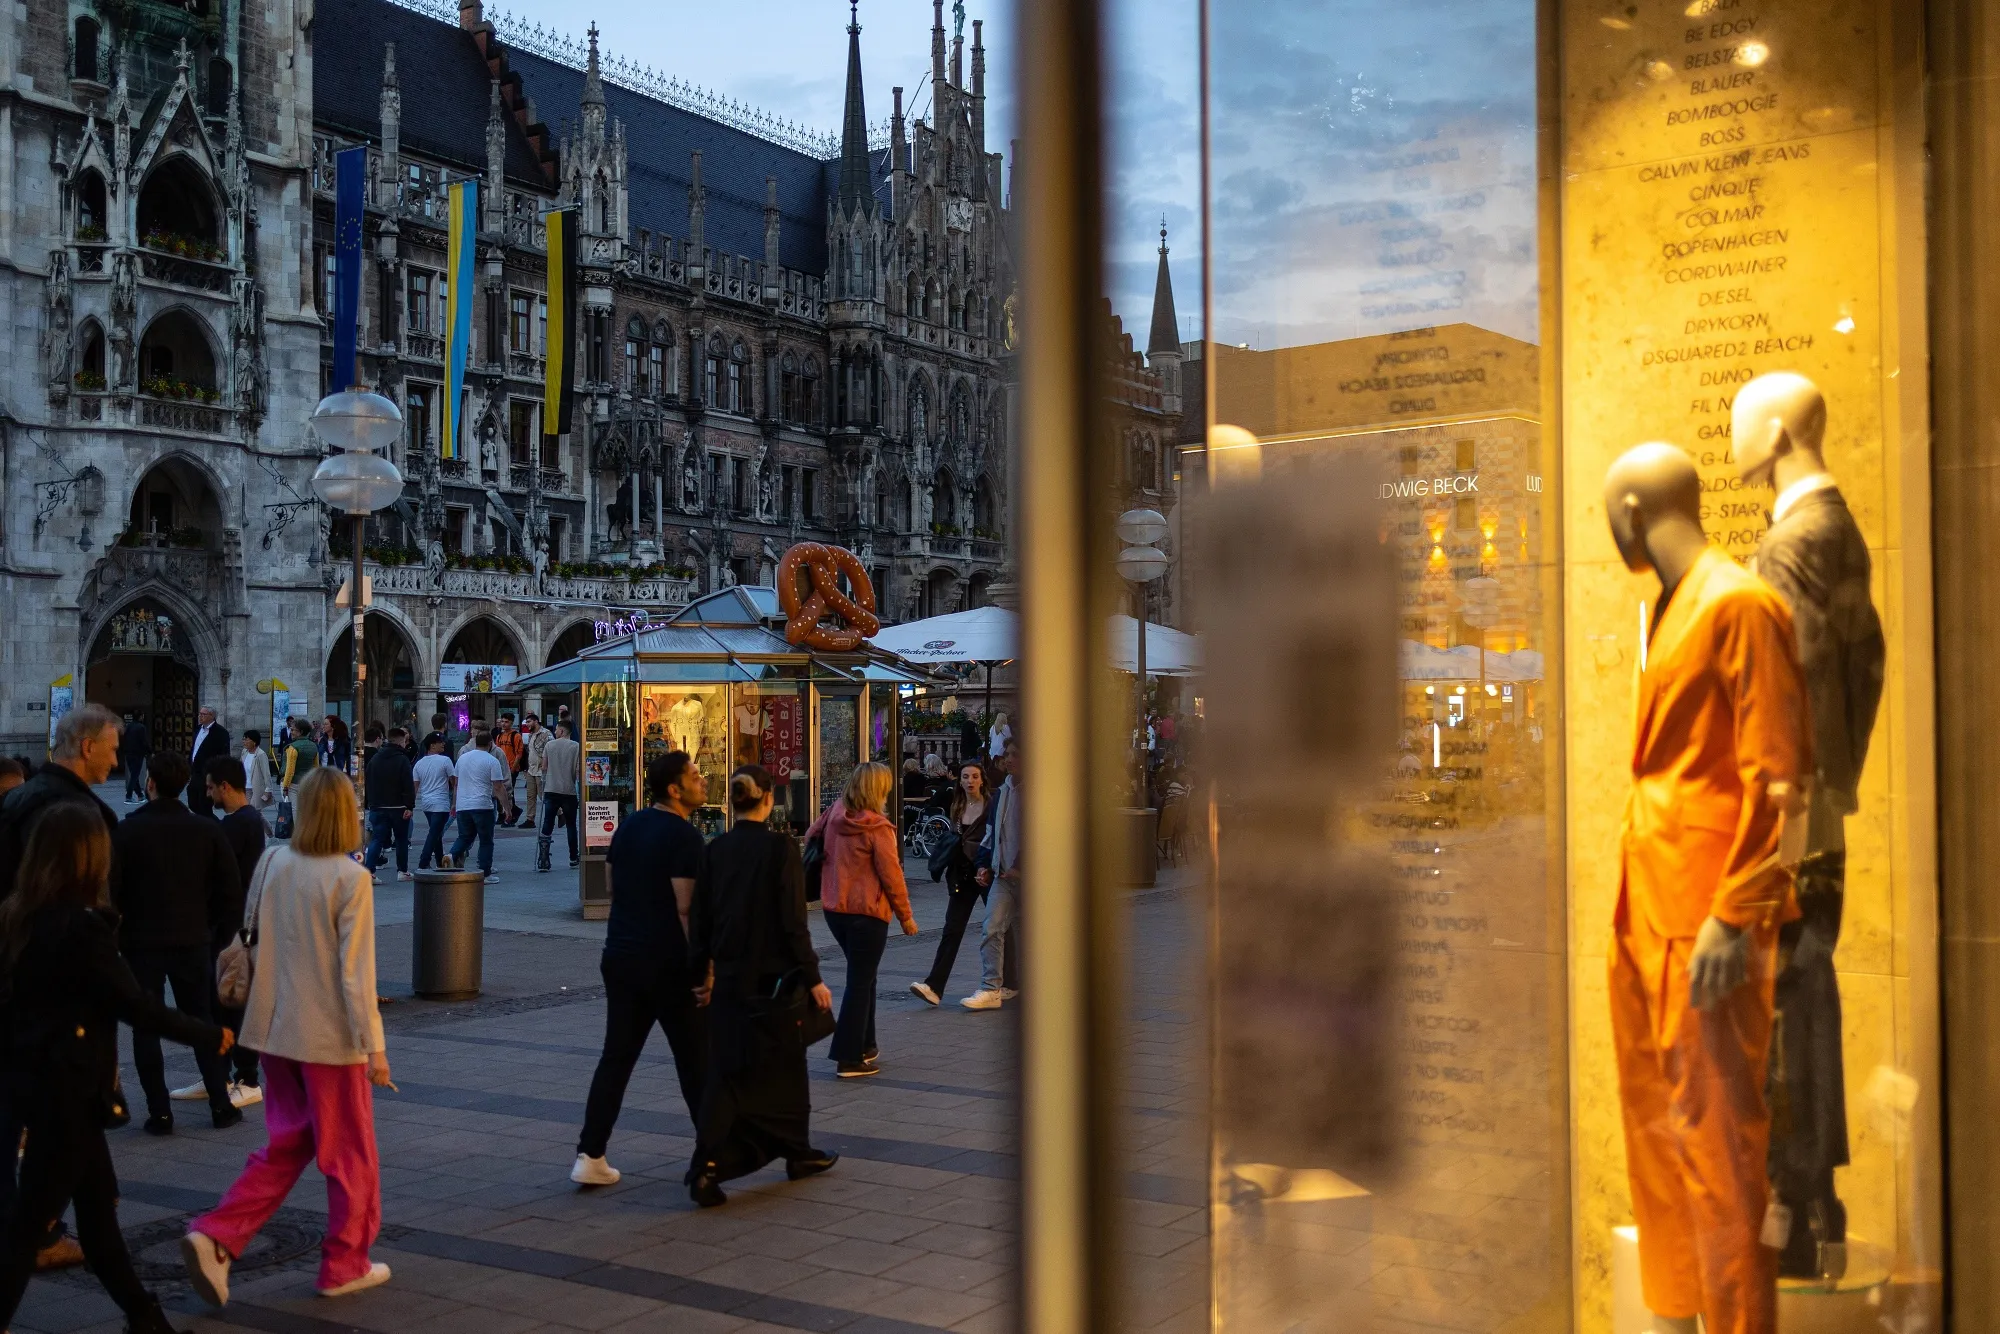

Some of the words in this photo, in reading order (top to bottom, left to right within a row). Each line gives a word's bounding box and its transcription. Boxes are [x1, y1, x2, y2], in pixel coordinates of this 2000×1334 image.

[1685, 26, 1704, 43] BE
[1710, 16, 1759, 39] EDGY
[1690, 71, 1755, 95] BLAUER
[1667, 93, 1779, 125] BOMBOOGIE
[1700, 126, 1745, 146] BOSS
[1639, 160, 1699, 182] CALVIN
[1755, 143, 1812, 165] JEANS
[1689, 178, 1761, 201] CINQUE
[1685, 204, 1765, 229] COLMAR
[1662, 229, 1789, 260] COPENHAGEN
[1664, 255, 1788, 284] CORDWAINER
[1698, 287, 1752, 307] DIESEL
[1684, 312, 1770, 335] DRYKORN
[1642, 341, 1746, 366] DSQUARED2
[1753, 334, 1814, 355] BEACH
[1700, 368, 1753, 386] DUNO
[1690, 399, 1711, 414] FIL
[1434, 476, 1479, 495] BECK
[1503, 686, 1511, 695] U
[780, 730, 789, 751] FC
